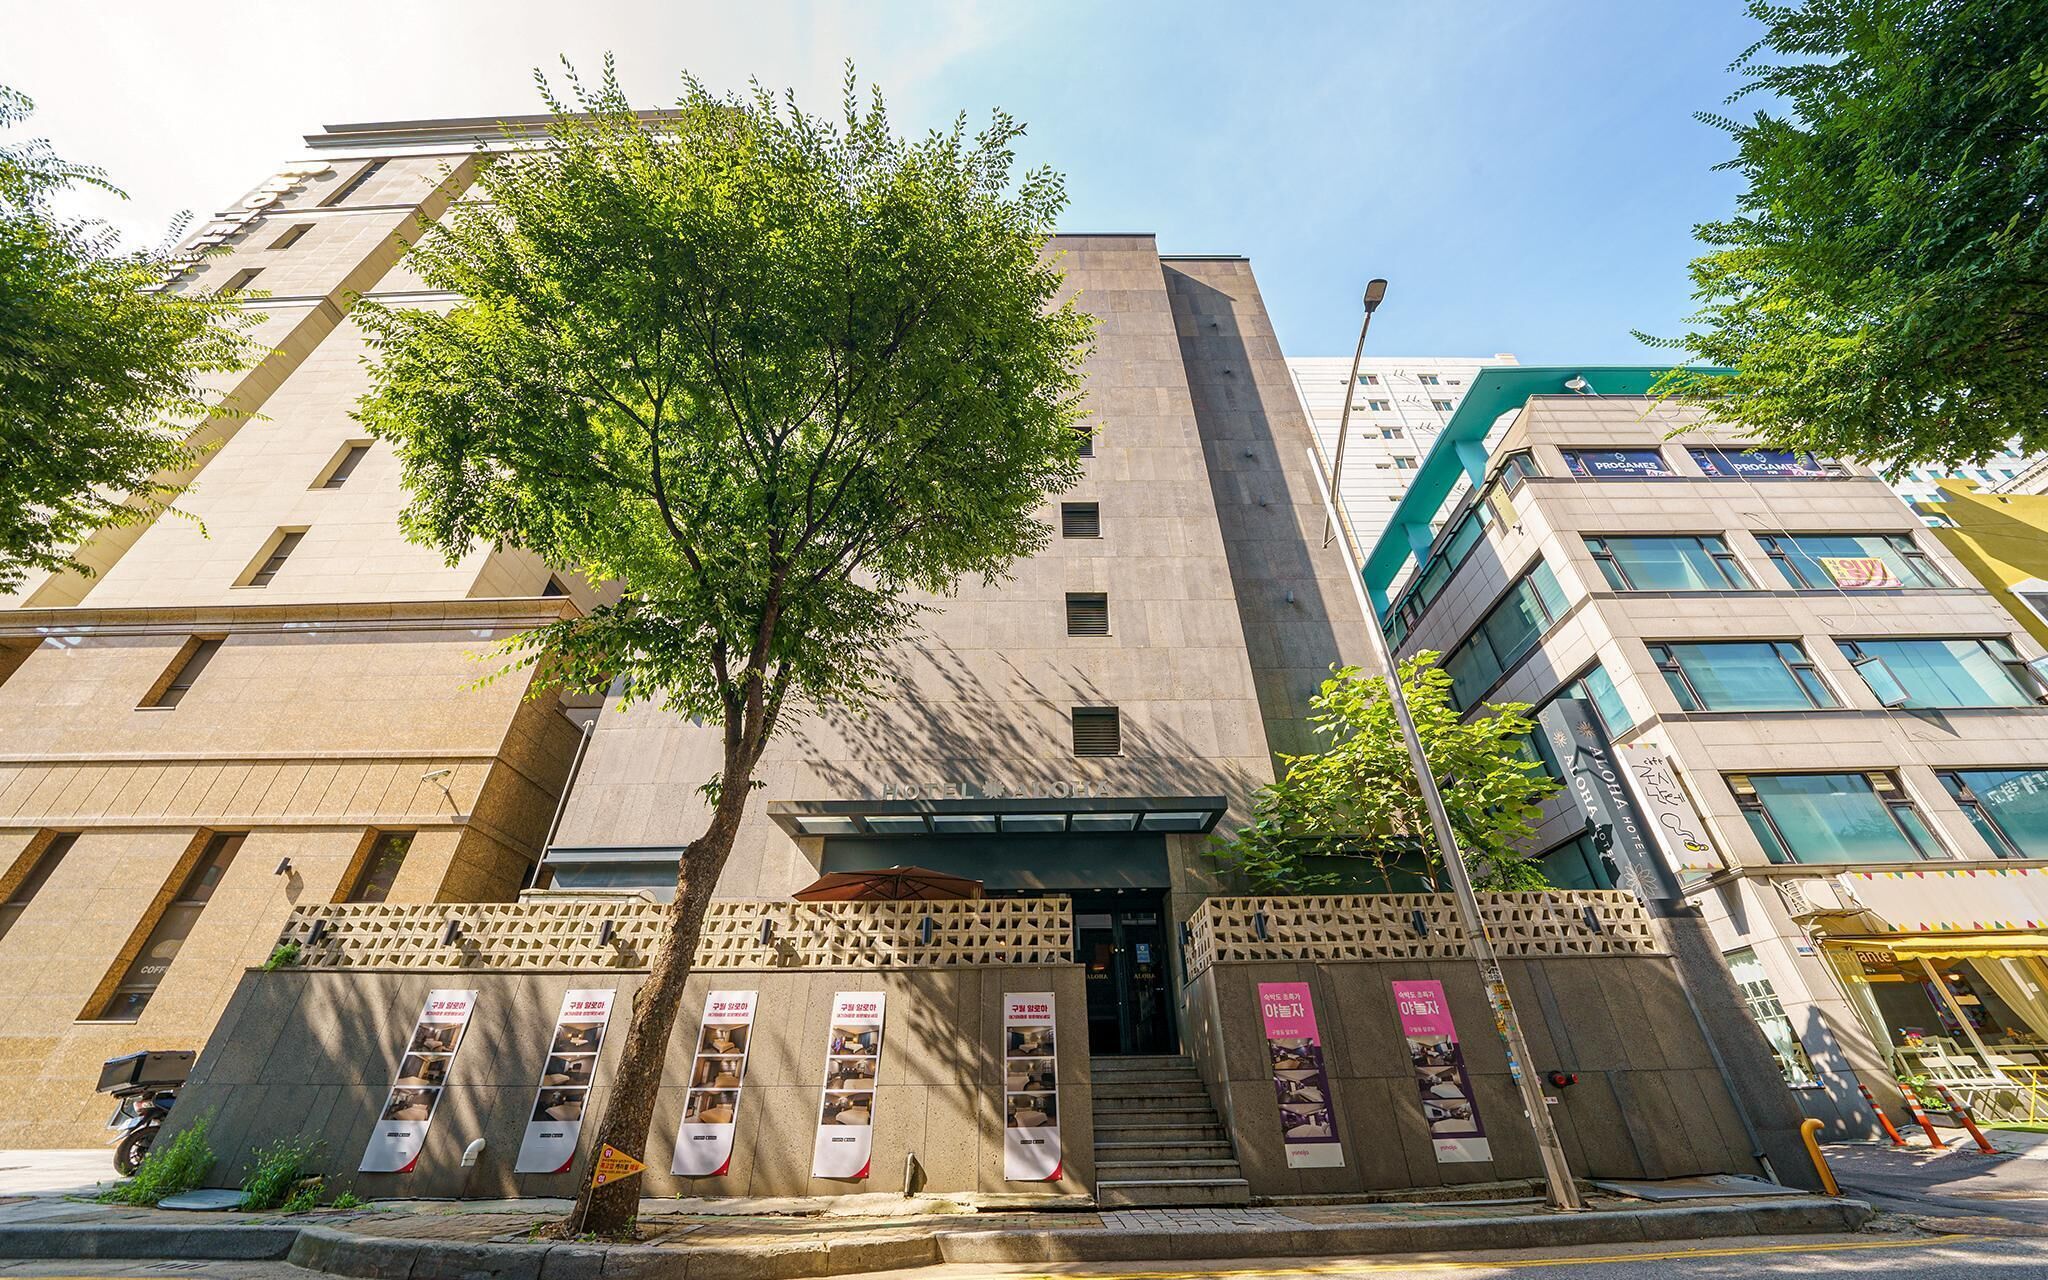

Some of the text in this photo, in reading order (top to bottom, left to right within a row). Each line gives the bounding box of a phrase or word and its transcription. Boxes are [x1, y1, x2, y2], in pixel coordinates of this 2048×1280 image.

[1594, 462, 1659, 470] PROGAMES
[1733, 463, 1804, 471] PROGAMES
[882, 781, 1113, 800] HOTEL ALOHA
[1589, 745, 1648, 858] ALOHA HOTEL
[1564, 754, 1617, 865] ALOHA HOTEL
[1265, 1003, 1304, 1018] 야놀자
[1400, 1001, 1439, 1015] 야놀자
